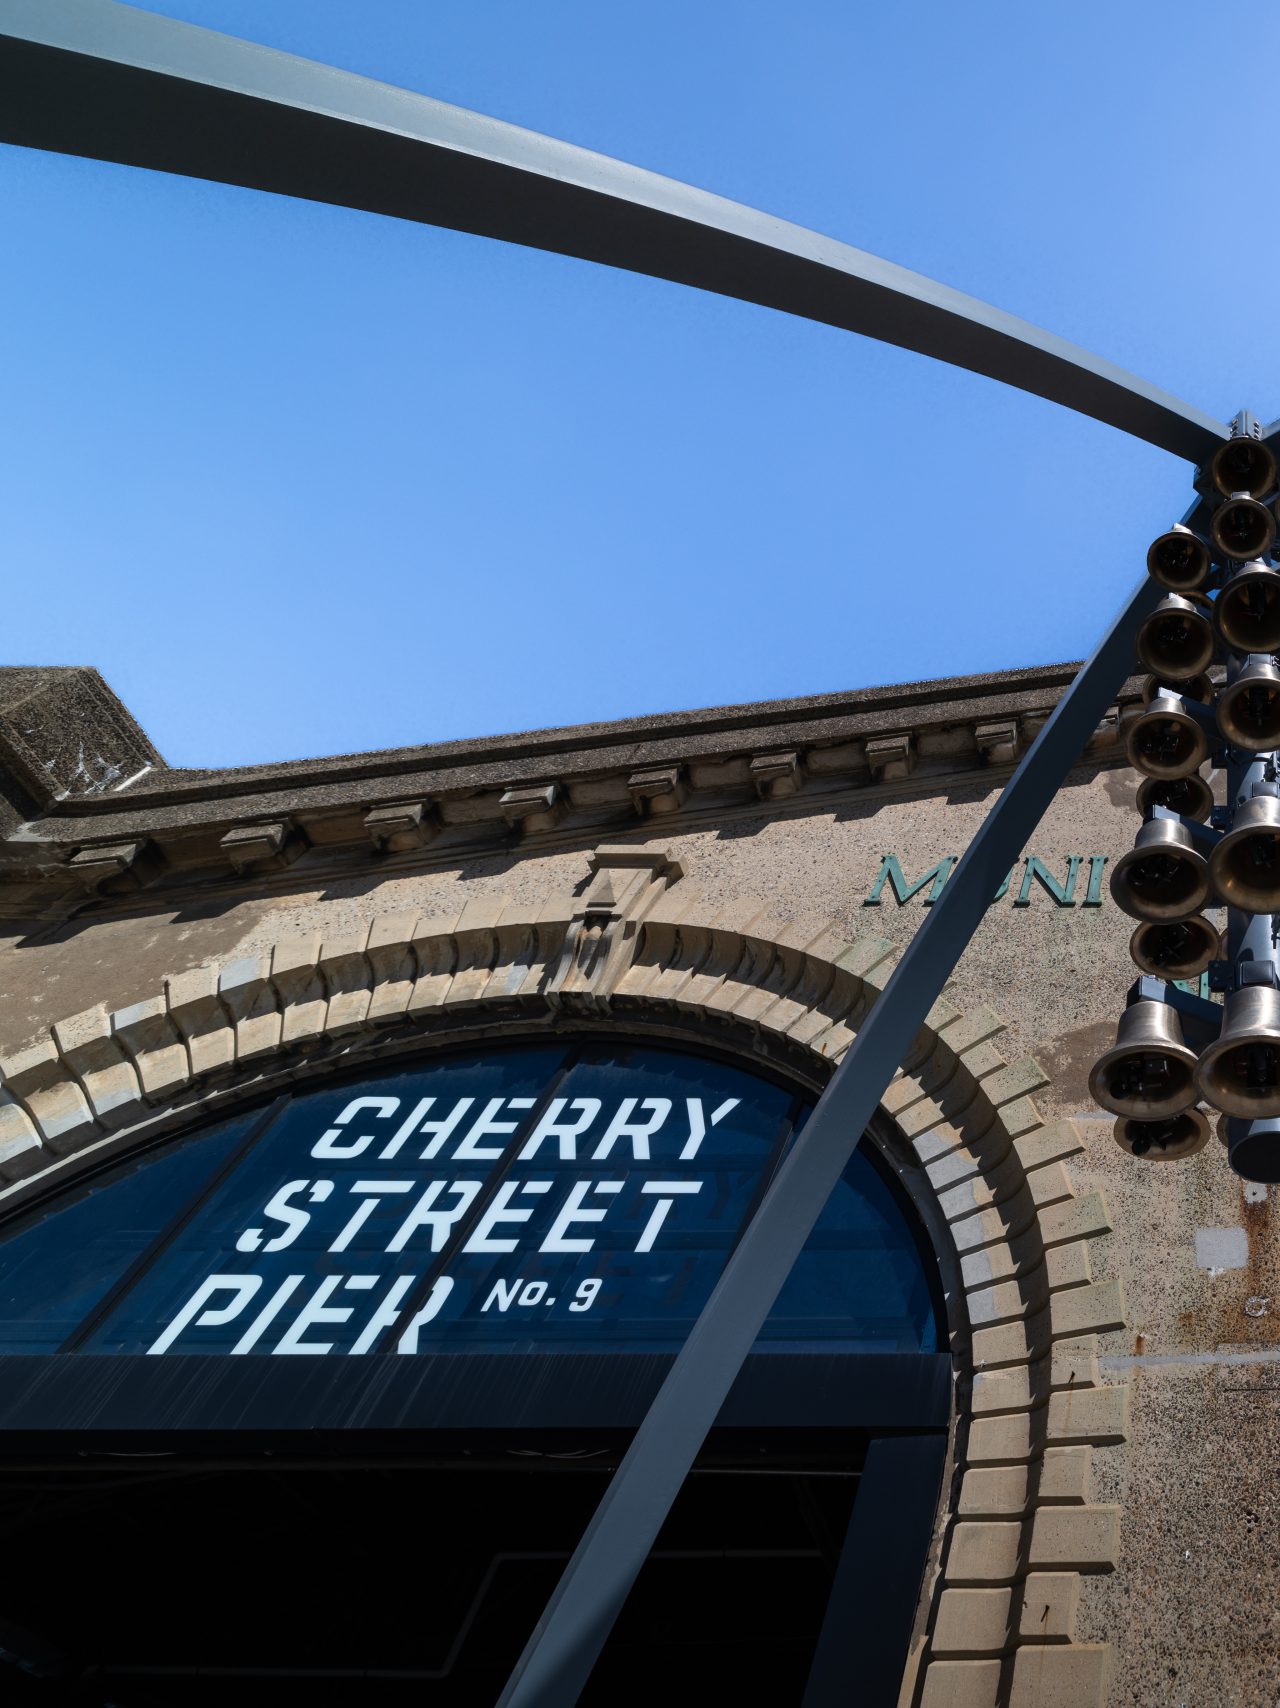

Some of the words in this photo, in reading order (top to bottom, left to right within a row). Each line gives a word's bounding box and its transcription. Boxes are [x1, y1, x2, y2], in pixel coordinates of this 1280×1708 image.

[311, 1096, 740, 1160] CHERRY
[236, 1180, 703, 1253] STREET
[146, 1275, 454, 1355] PIER
[480, 1278, 556, 1312] No.
[568, 1278, 603, 1312] 9
